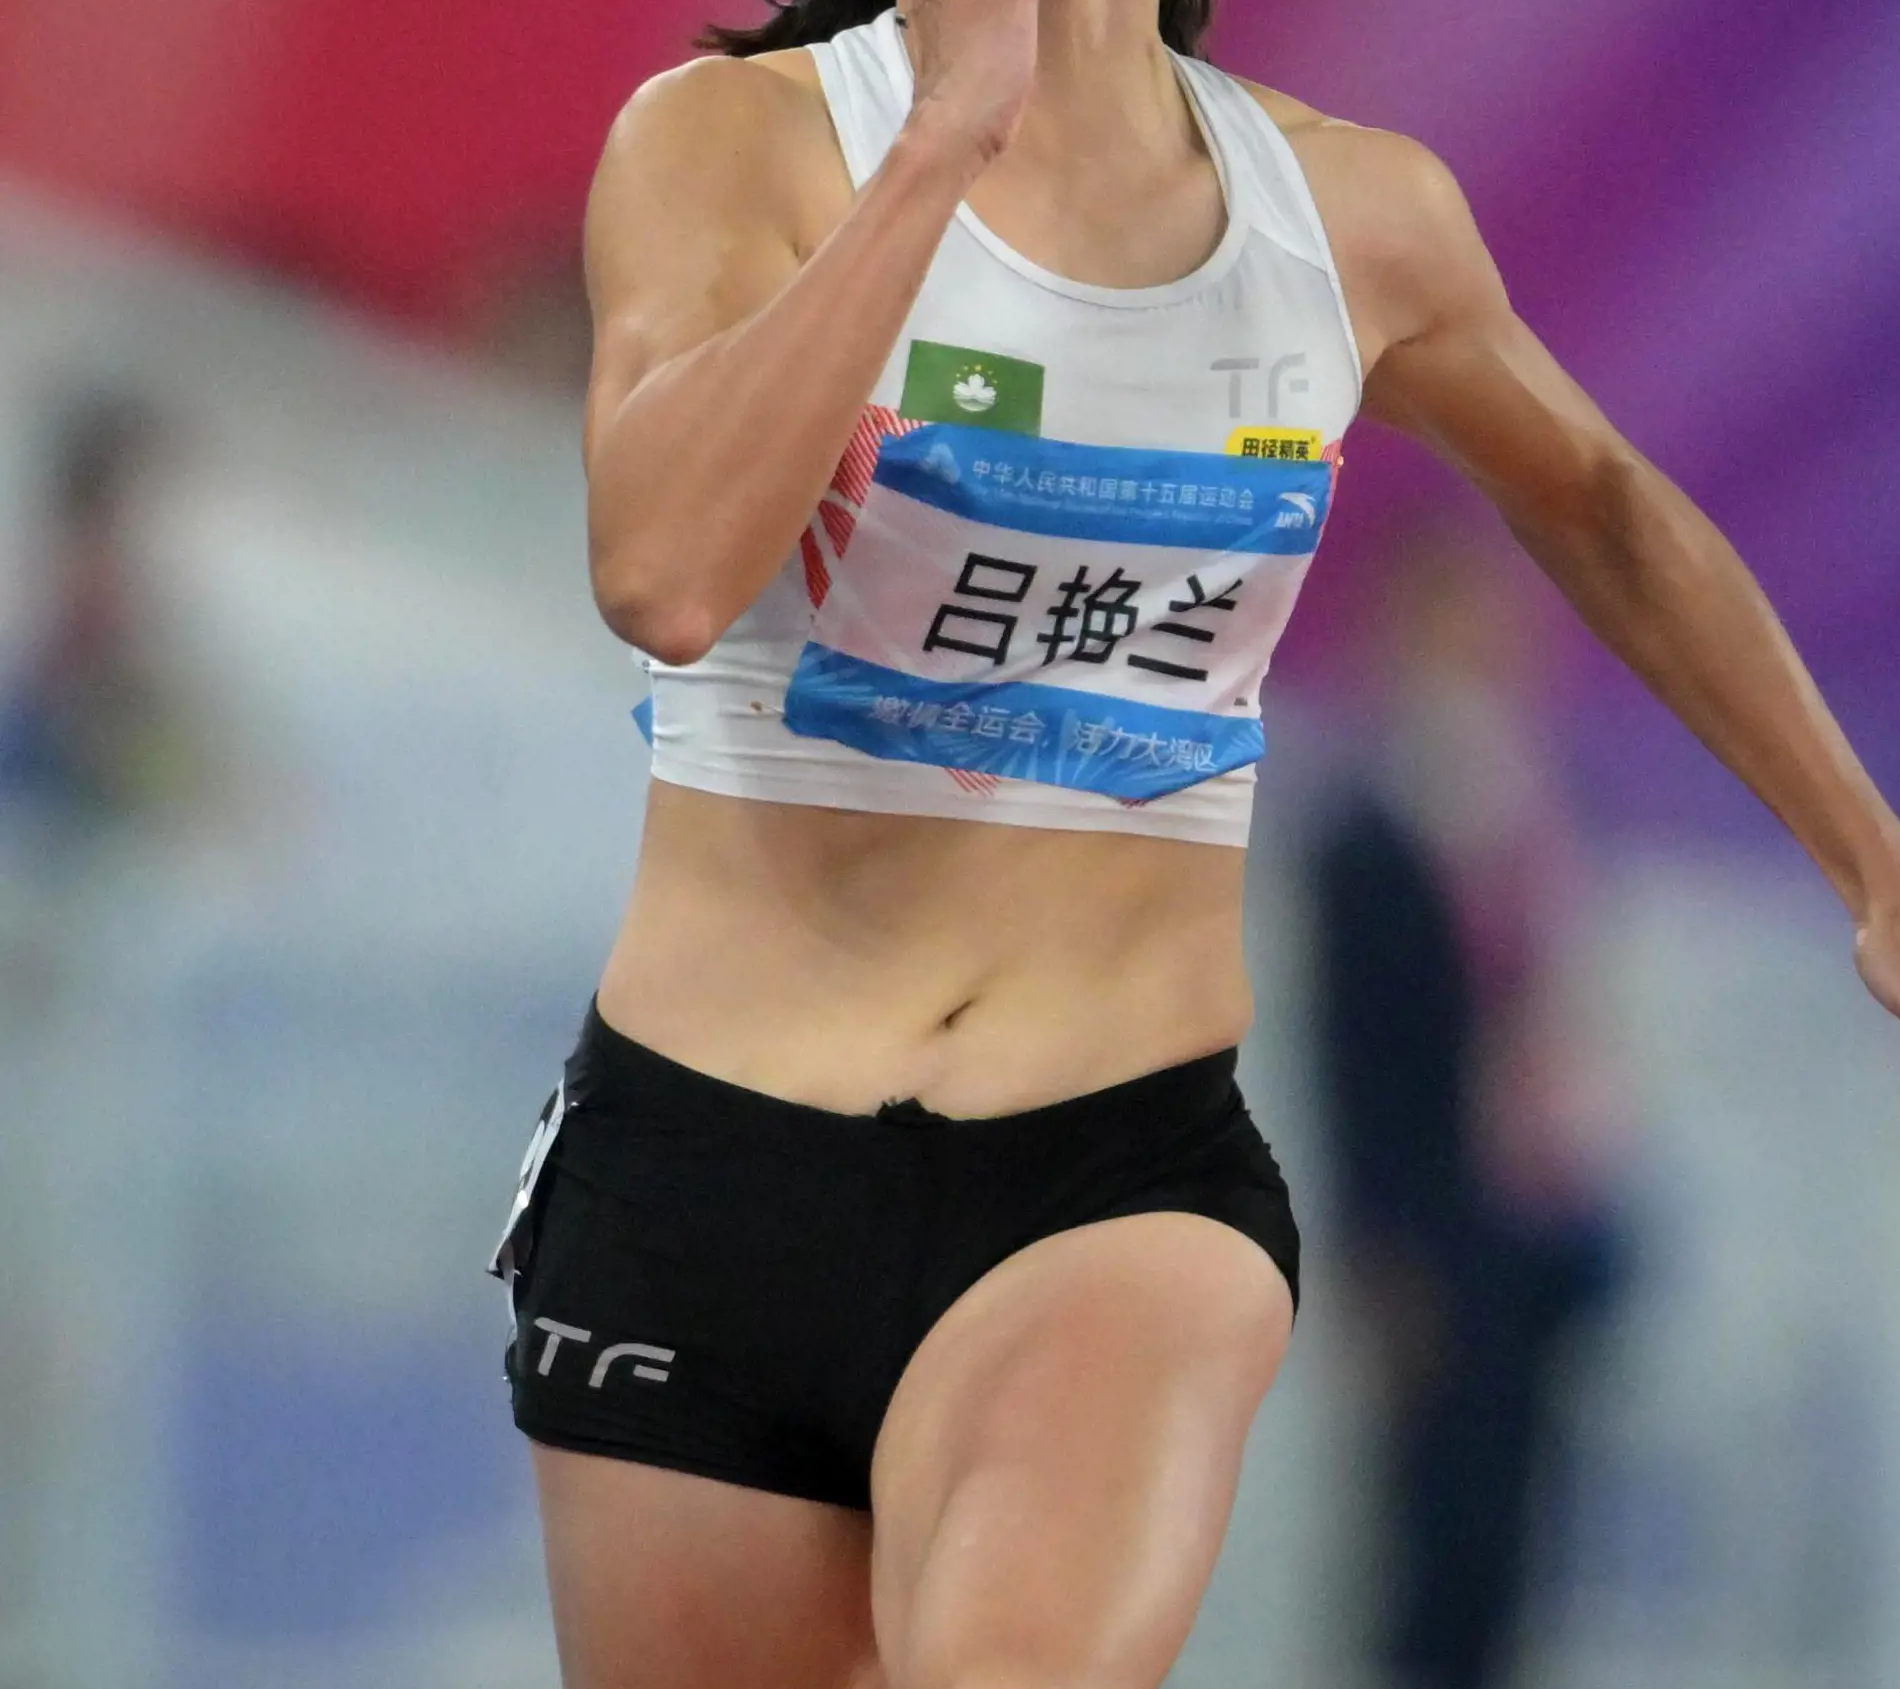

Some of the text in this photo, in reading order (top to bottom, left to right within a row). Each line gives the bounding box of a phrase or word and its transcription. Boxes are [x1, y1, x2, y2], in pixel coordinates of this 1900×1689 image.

[972, 459, 1255, 511] 中华人民共和国第十五届运动会
[922, 551, 1244, 683] 吕艳兰
